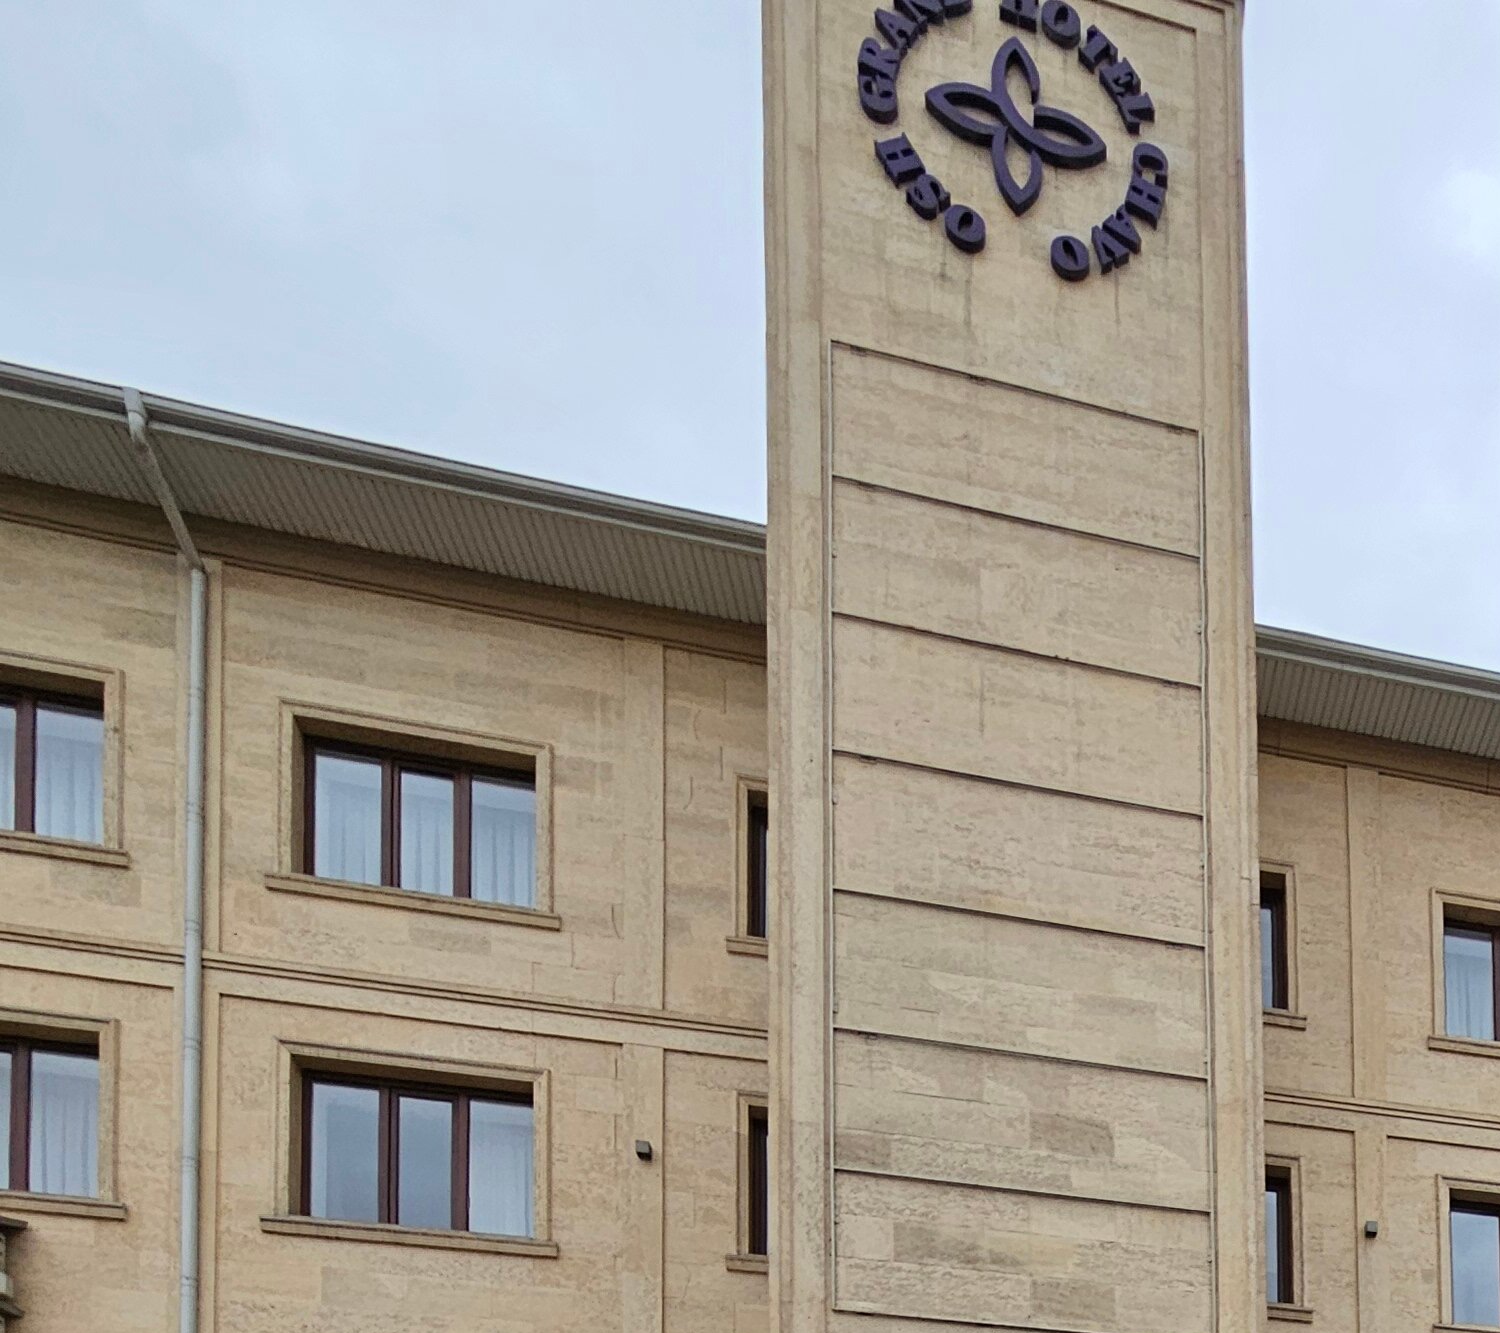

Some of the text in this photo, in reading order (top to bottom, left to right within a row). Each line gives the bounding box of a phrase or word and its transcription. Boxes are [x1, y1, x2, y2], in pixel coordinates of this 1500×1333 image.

[858, 0, 972, 124] GRAN
[874, 132, 986, 254] OSH
[1050, 142, 1168, 281] CHAVO
